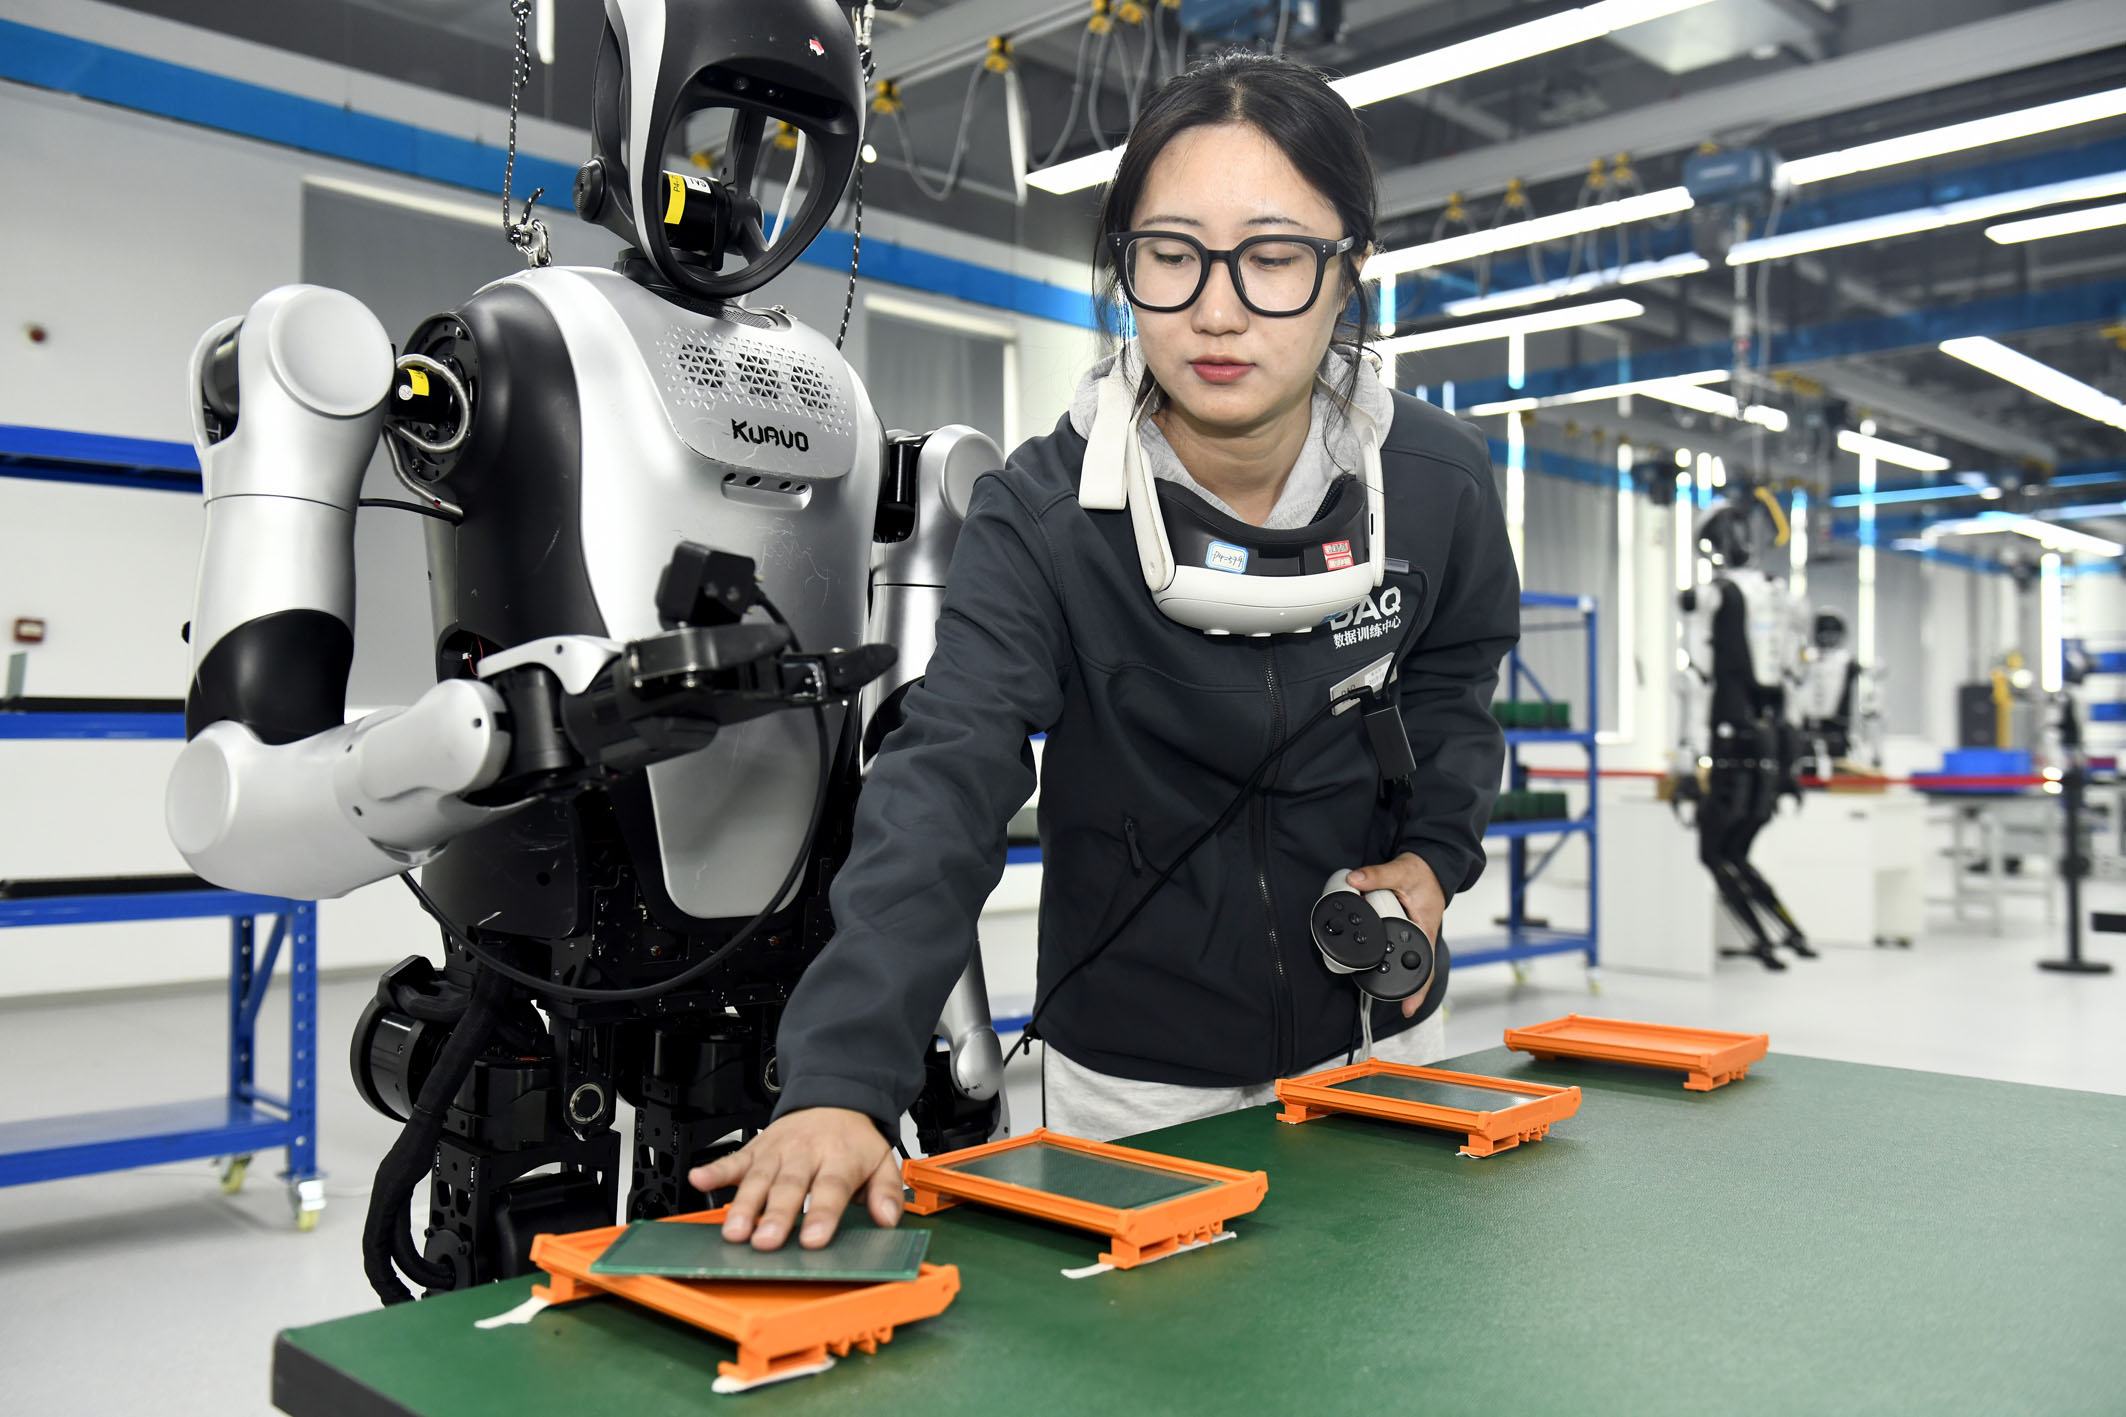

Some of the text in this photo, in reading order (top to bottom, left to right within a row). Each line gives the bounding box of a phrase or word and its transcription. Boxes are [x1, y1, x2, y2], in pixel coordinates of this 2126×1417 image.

[731, 418, 809, 452] KUAVO
[1333, 615, 1402, 649] 数据训练中心
